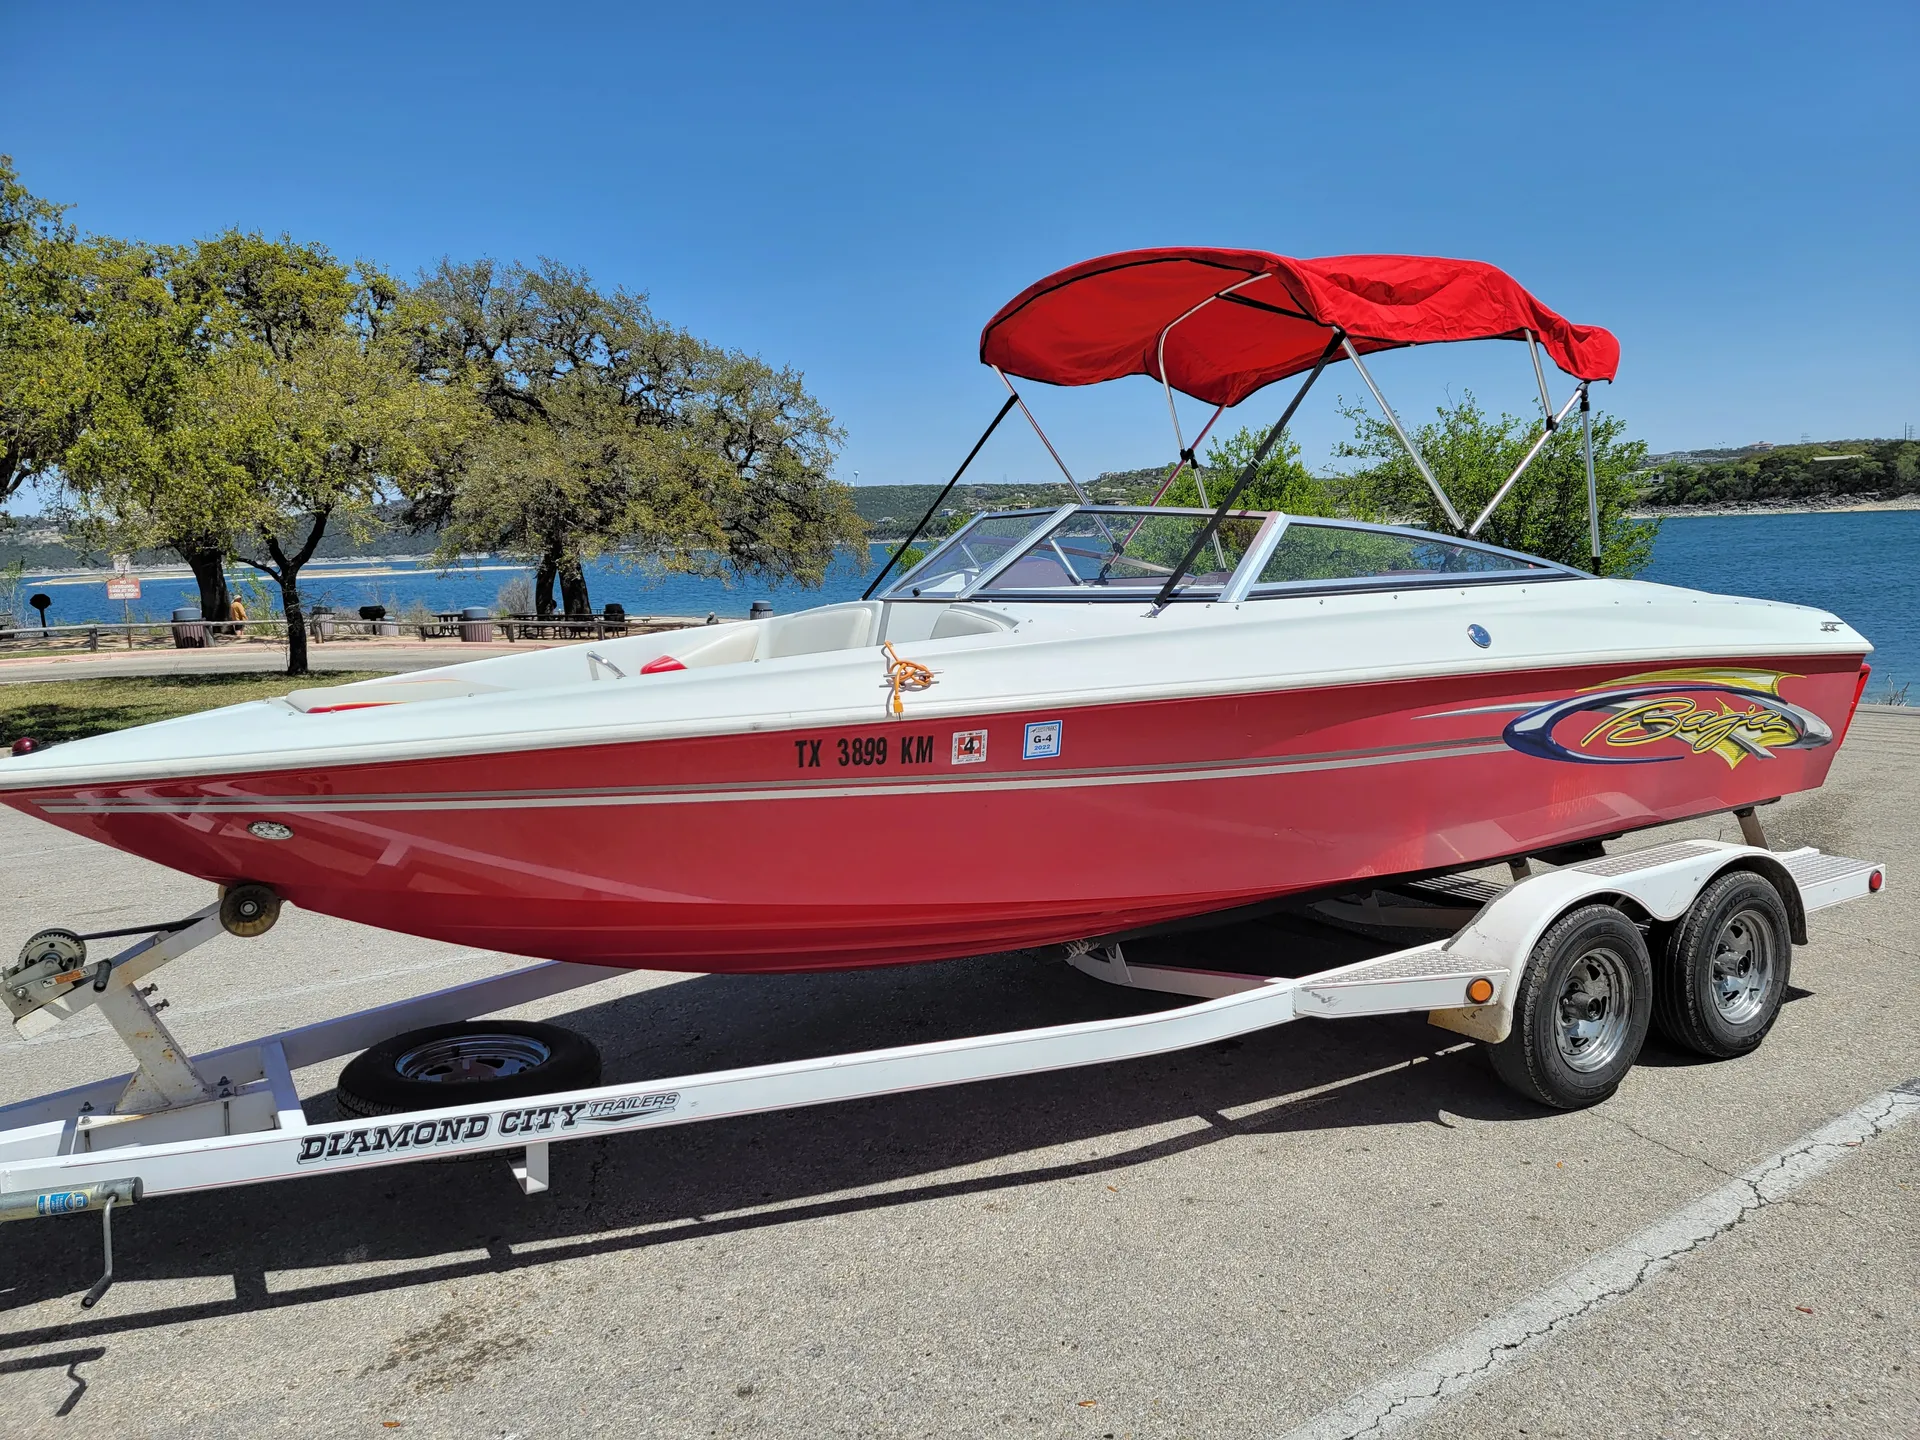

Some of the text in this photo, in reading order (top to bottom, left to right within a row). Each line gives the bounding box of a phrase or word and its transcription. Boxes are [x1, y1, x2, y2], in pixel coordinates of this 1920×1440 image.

[1033, 734, 1052, 744] G-4
[1581, 696, 1789, 753] Baja
[795, 738, 823, 768] TX
[837, 736, 888, 767] 3899
[900, 735, 934, 765] KM
[964, 735, 975, 754] 4
[298, 1092, 681, 1163] DIAMOND CITY TRAILERS
